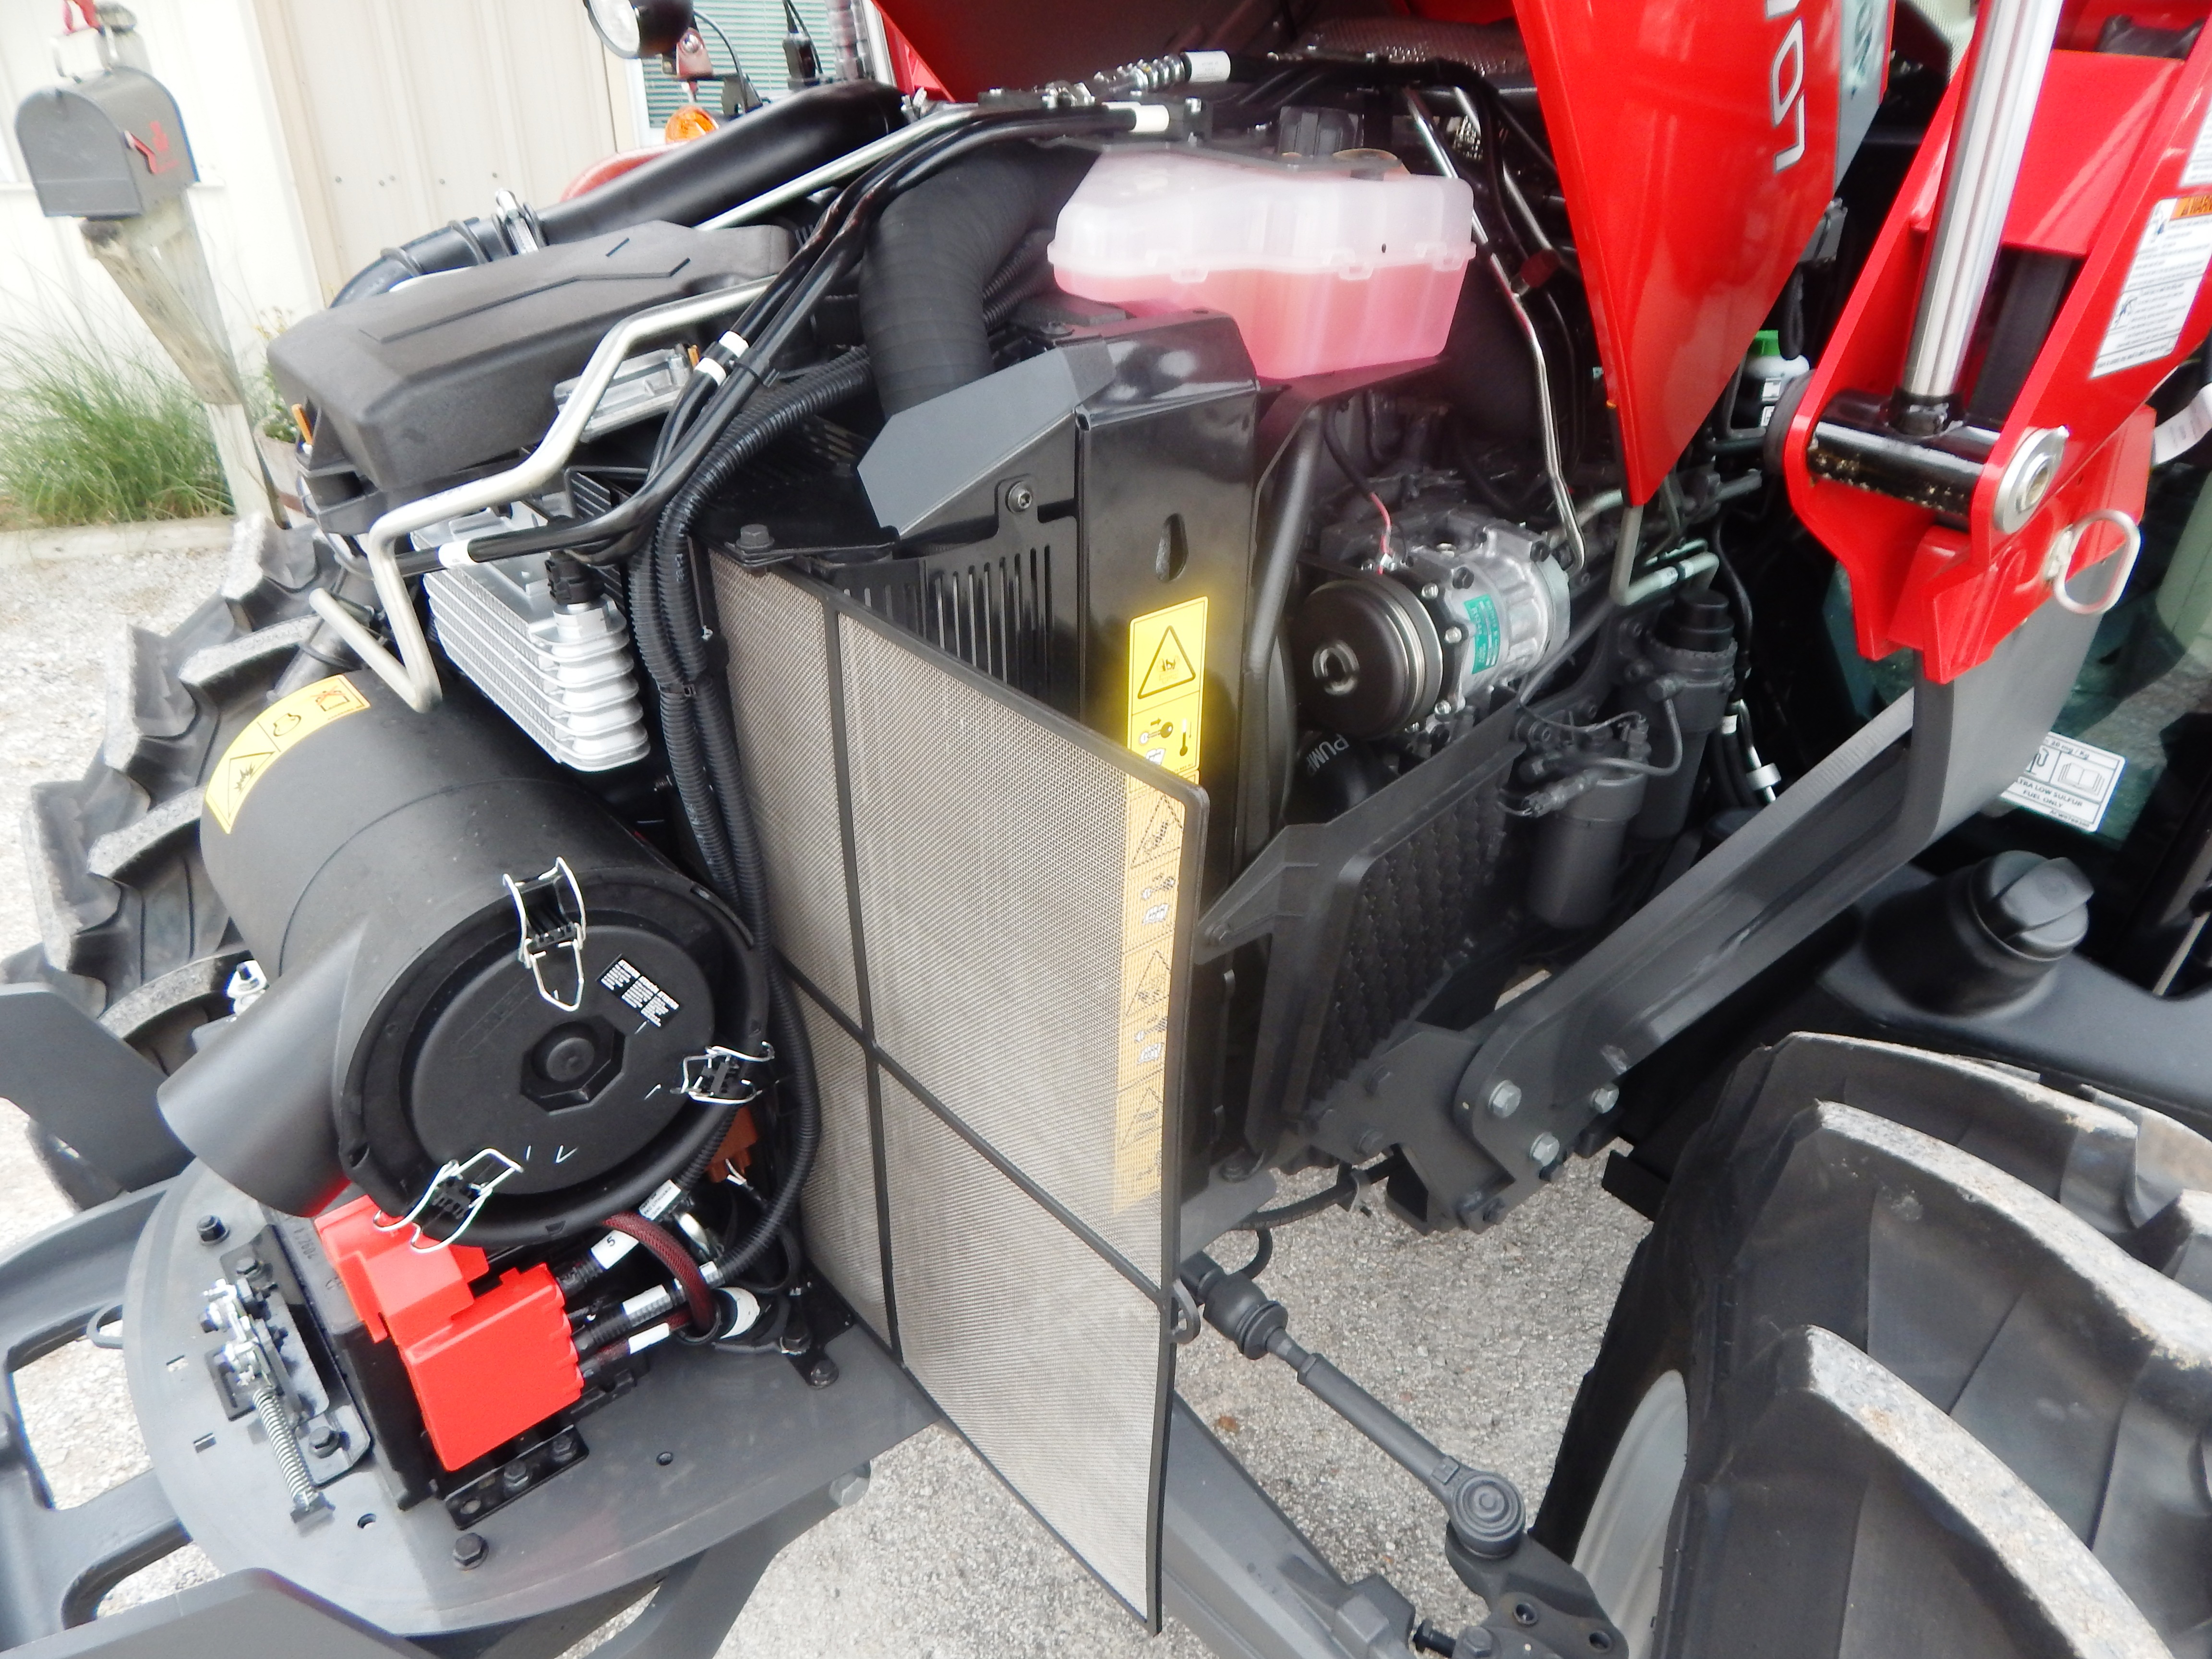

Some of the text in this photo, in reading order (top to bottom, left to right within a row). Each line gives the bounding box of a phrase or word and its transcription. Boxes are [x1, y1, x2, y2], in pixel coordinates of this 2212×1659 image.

[1306, 733, 1349, 776] PUMP
[2022, 790, 2064, 808] FUEL ONLY
[2034, 783, 2052, 795] LOW
[2053, 792, 2083, 807] SULFUR
[606, 1236, 616, 1247] 5
